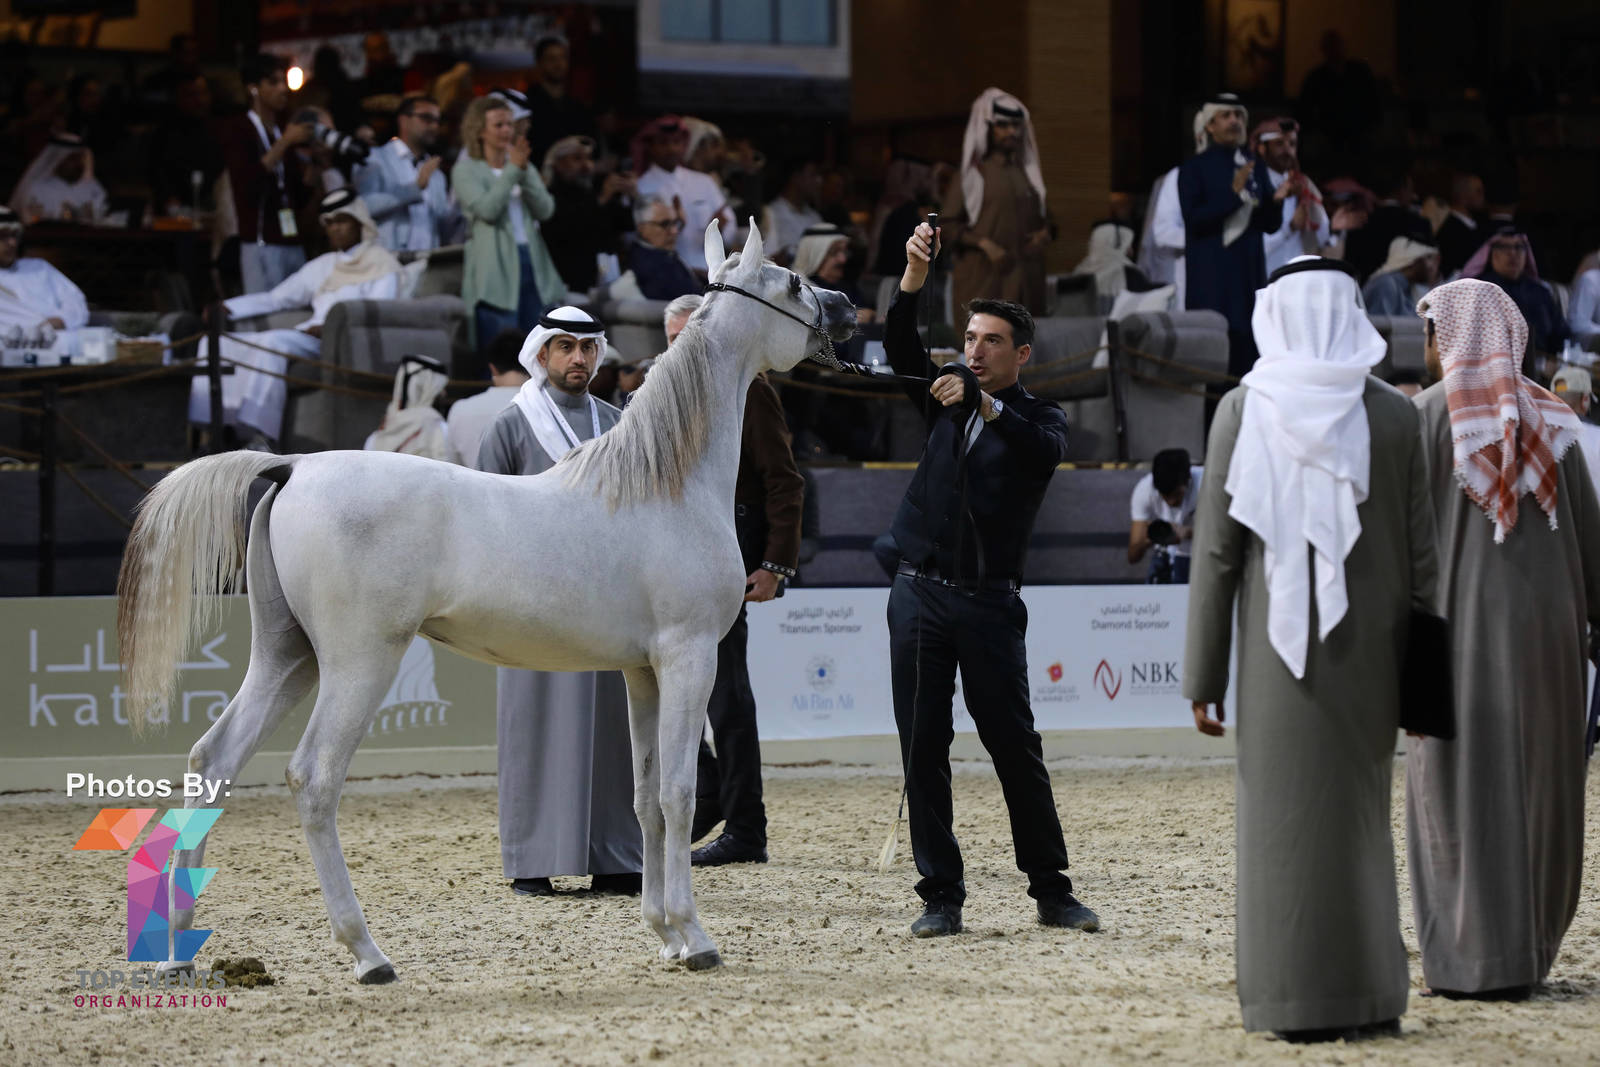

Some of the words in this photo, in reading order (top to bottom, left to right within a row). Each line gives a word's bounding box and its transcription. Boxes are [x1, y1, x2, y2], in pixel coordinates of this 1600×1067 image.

[779, 623, 822, 633] Titanium
[824, 622, 863, 634] Sponsor
[1091, 619, 1132, 630] Diamond
[1134, 618, 1170, 631] Sponsor
[1131, 661, 1179, 683] NBK
